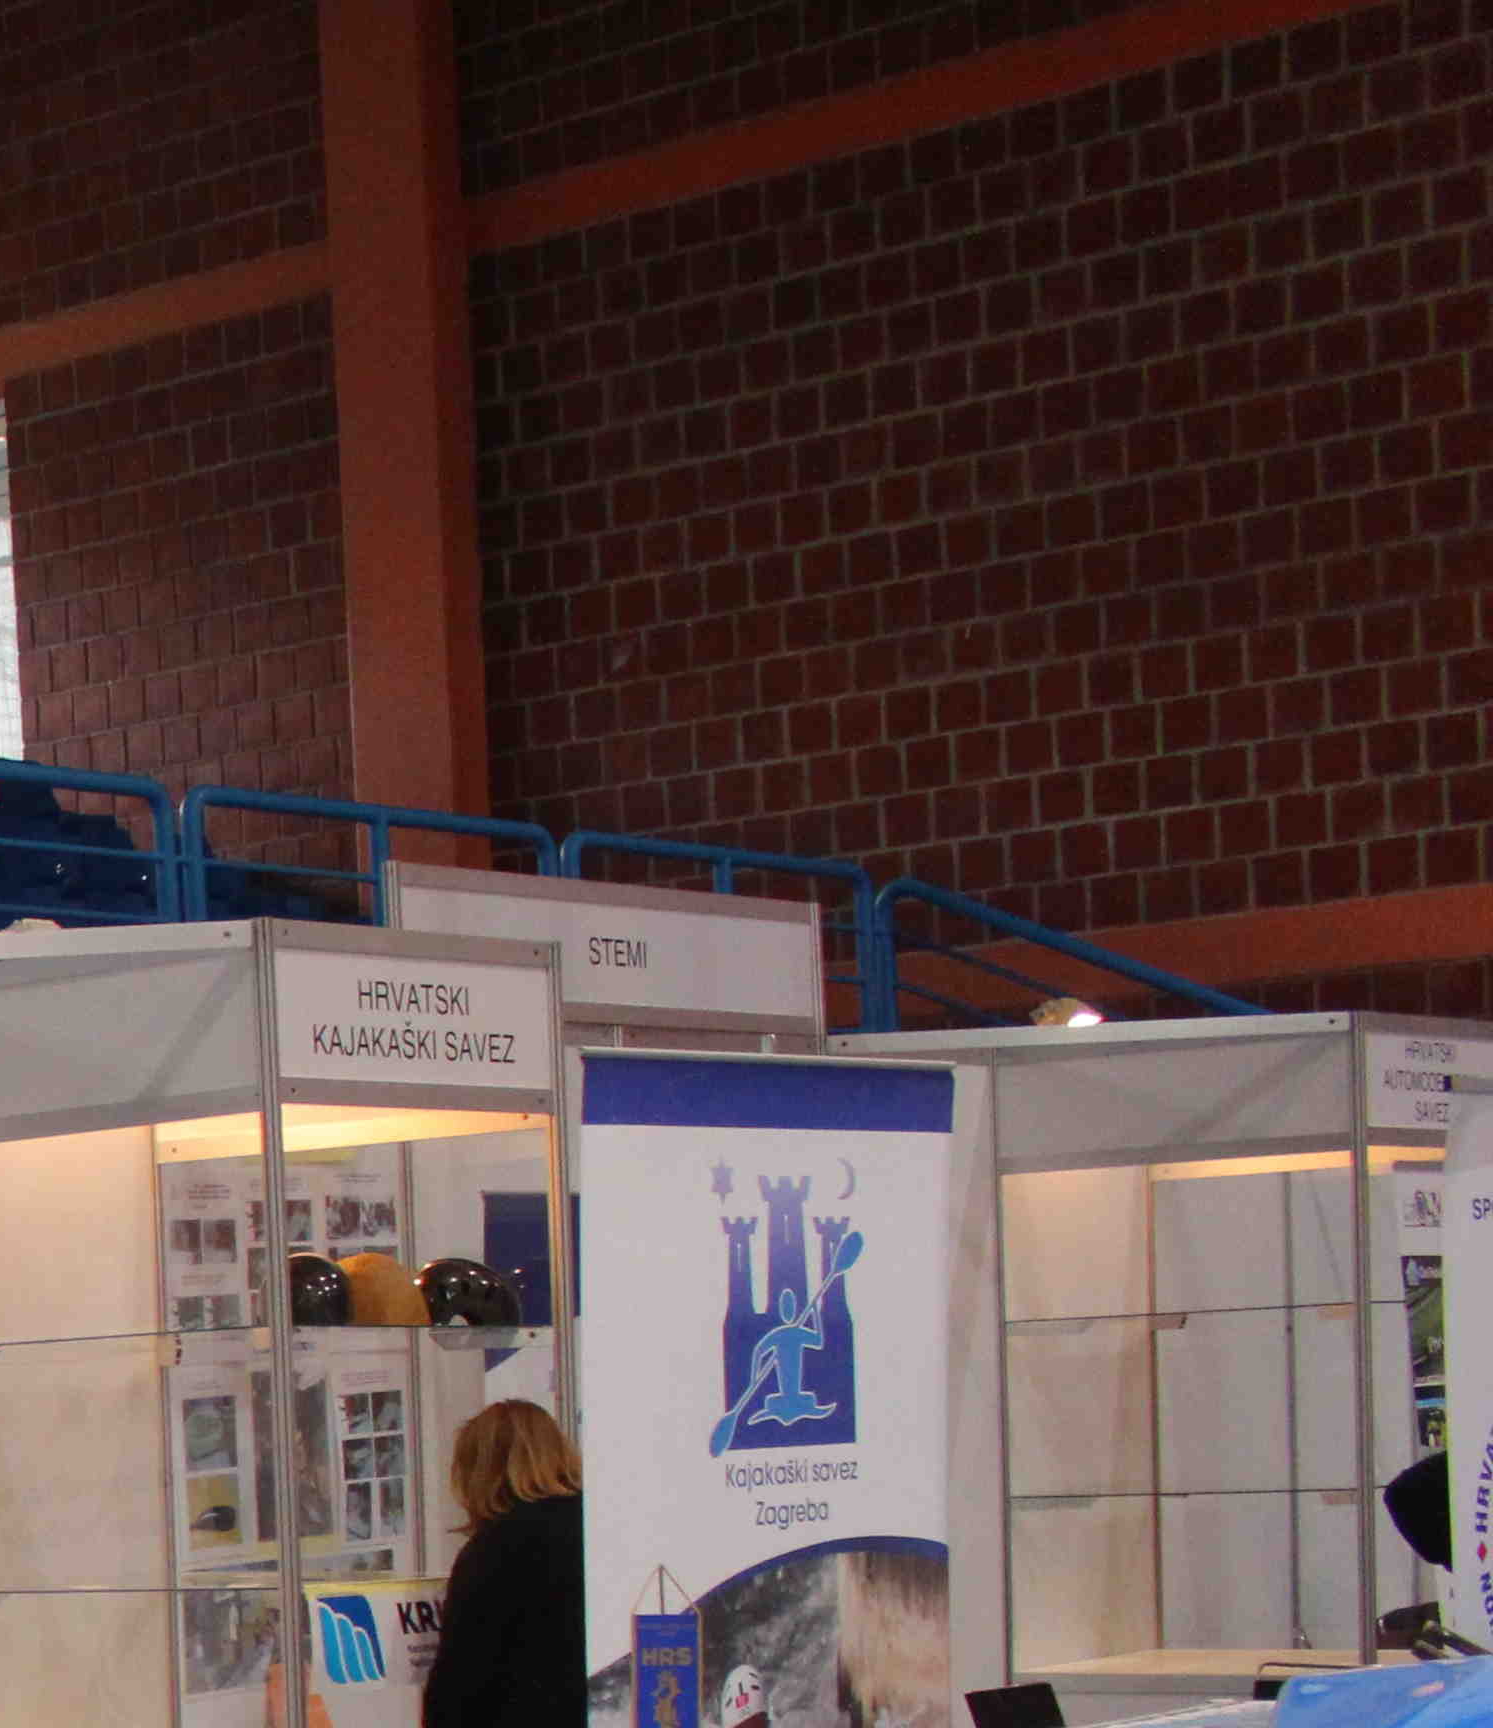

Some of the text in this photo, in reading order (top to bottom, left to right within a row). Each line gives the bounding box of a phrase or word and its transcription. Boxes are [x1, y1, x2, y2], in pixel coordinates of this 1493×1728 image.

[587, 936, 648, 969] STEMI
[356, 978, 471, 1016] HRVATSKI
[312, 1020, 516, 1064] KAJAKAŠKI SAVEZ
[1472, 1198, 1493, 1221] SP
[725, 1459, 859, 1493] Kajakaški savez
[755, 1497, 829, 1530] Zagreba
[396, 1600, 441, 1635] KR
[642, 1647, 693, 1667] HRS
